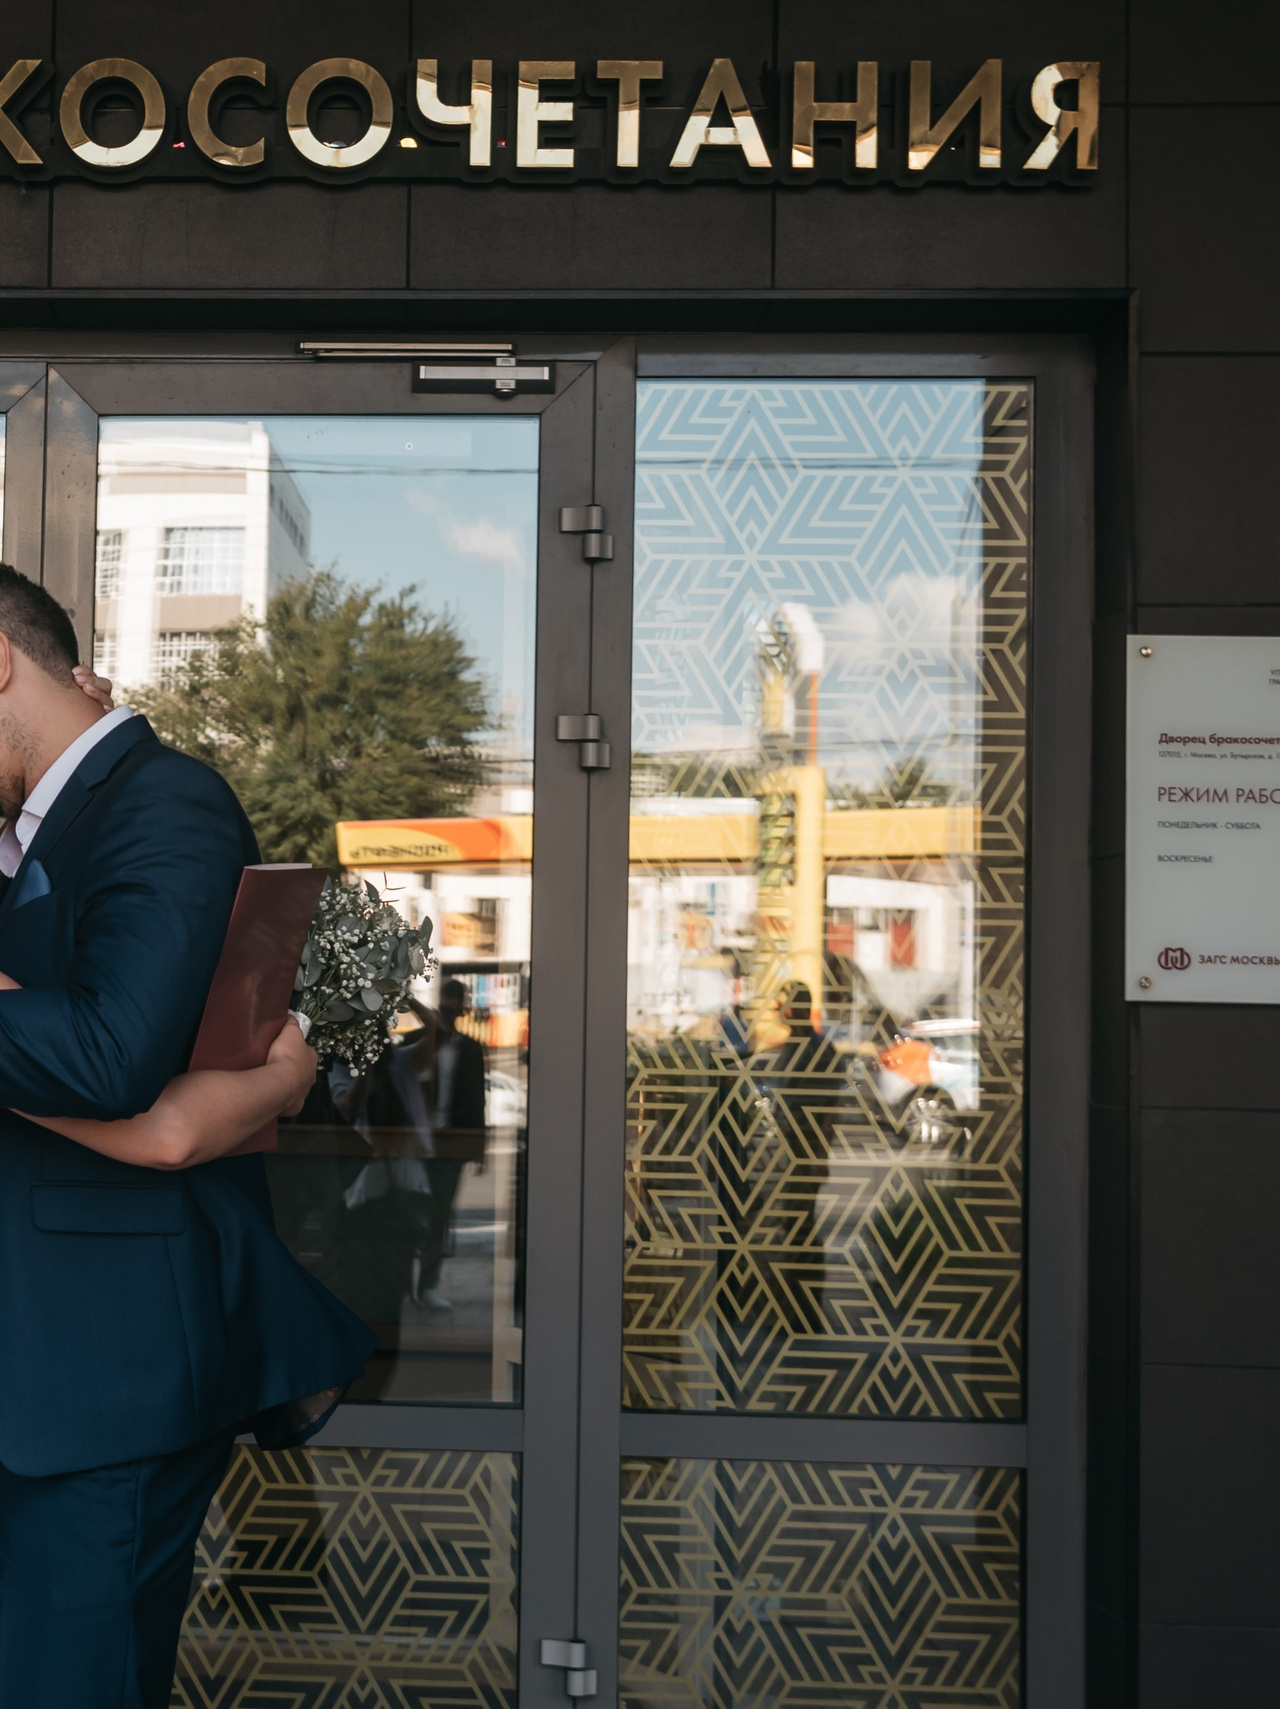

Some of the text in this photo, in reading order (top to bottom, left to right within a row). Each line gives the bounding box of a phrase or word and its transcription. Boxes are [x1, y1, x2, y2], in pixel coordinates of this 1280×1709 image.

[1158, 733, 1207, 746] Дворец
[1157, 786, 1229, 803] РЕЖИМ
[1157, 820, 1218, 829] ПОНЕДЕЛЬНИК
[1224, 822, 1261, 830] СУББОТА
[1157, 855, 1213, 863] ВОСКРЕСЕНЬЕ
[1198, 955, 1227, 965] ЗАГС
